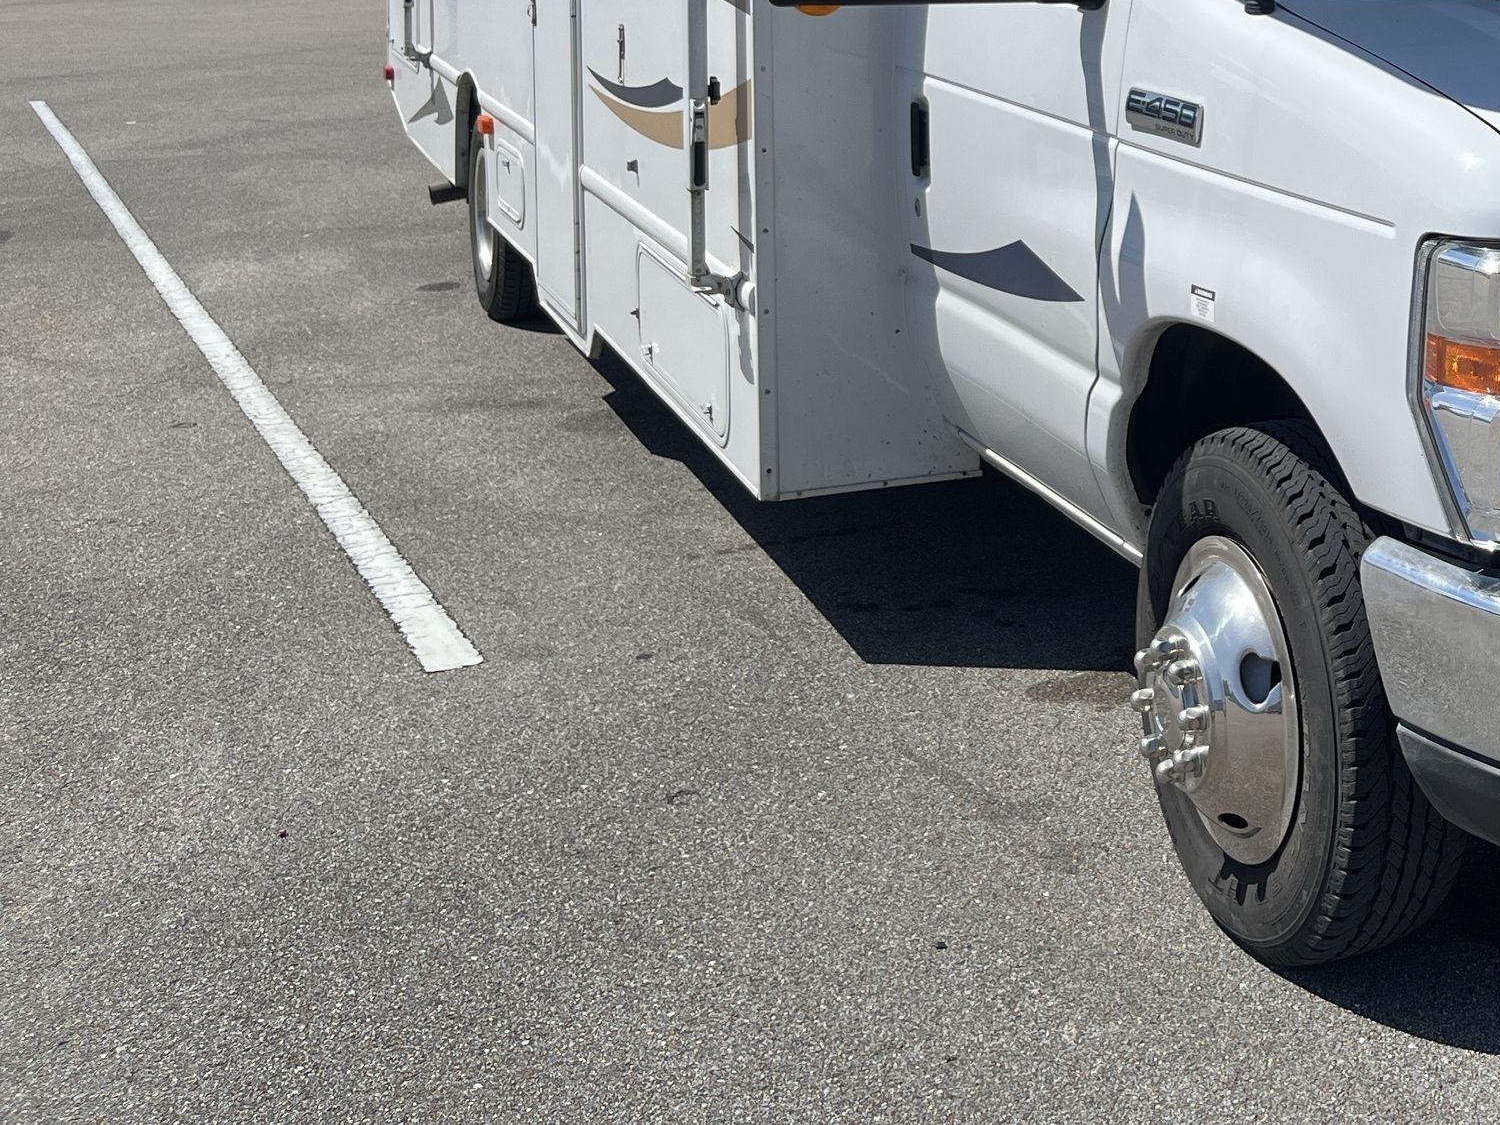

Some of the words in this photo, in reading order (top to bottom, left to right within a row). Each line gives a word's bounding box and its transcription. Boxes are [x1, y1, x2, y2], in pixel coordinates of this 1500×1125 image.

[1126, 89, 1198, 129] E-450
[1154, 122, 1175, 135] SUPER
[1176, 129, 1195, 141] DUTY
